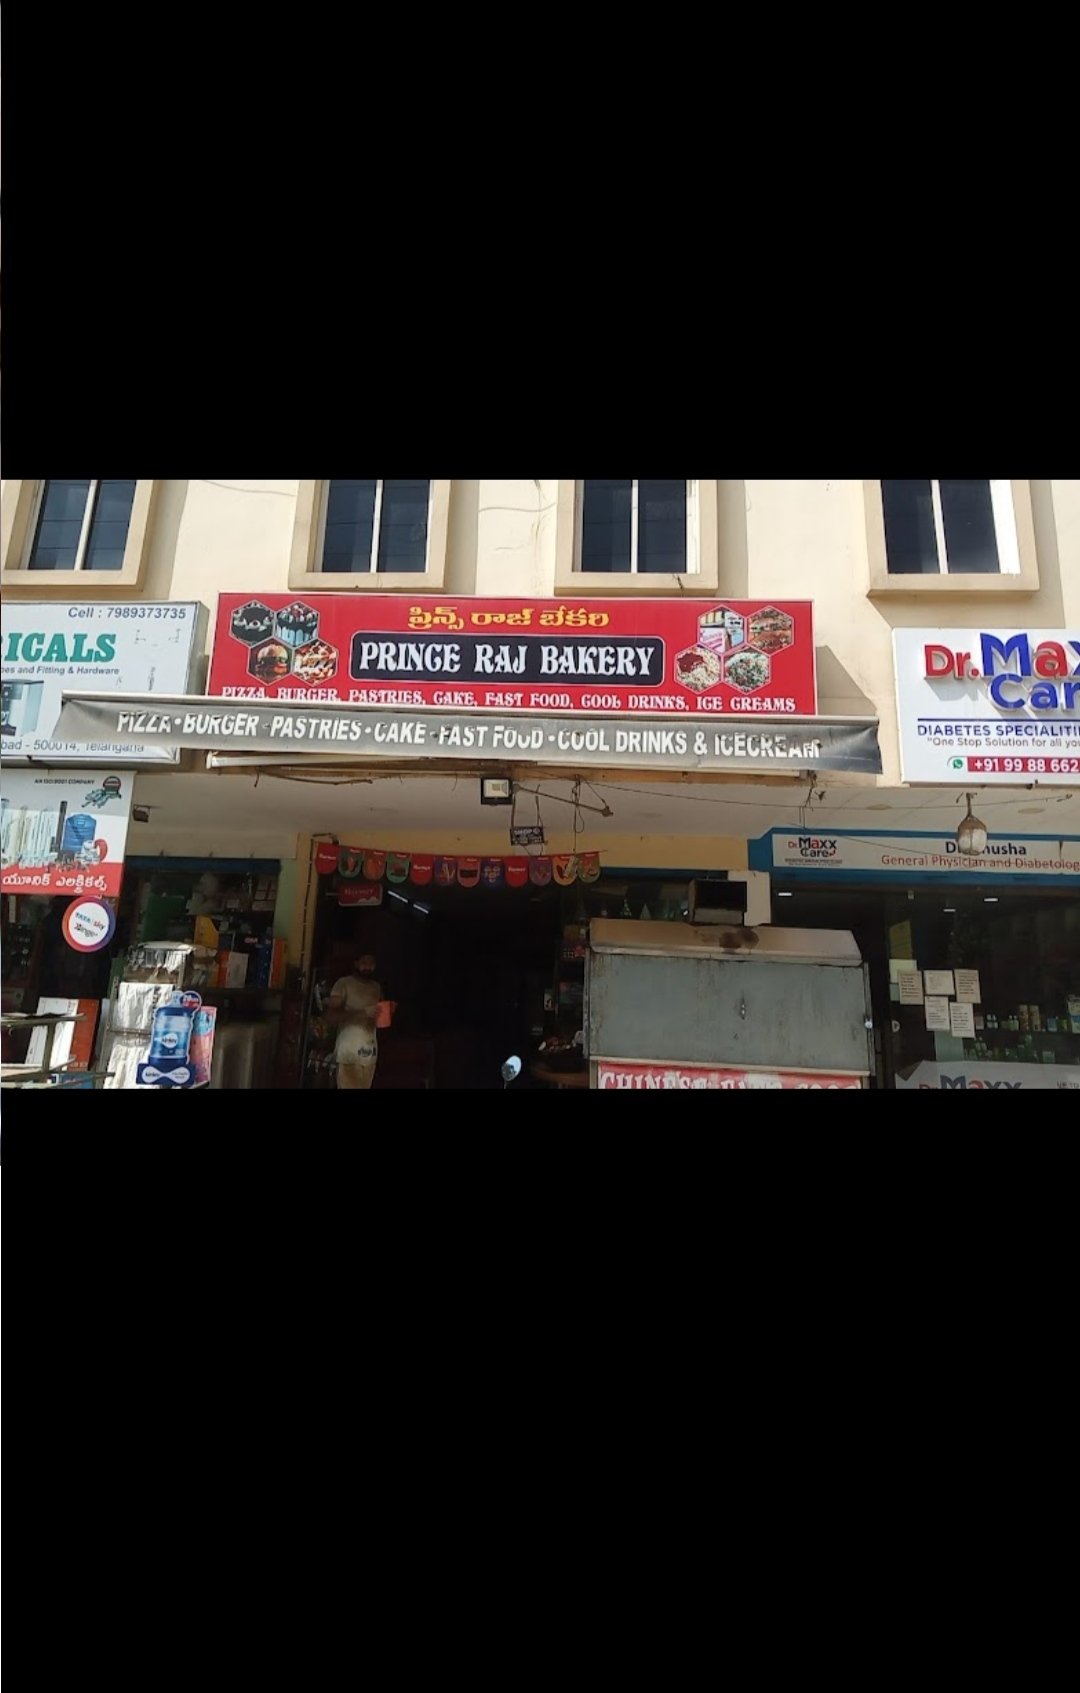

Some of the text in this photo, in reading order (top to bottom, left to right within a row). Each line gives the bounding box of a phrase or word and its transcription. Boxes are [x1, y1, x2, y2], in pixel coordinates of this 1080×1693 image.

[68, 606, 94, 619] Cell
[107, 607, 187, 620] 7989373735
[471, 608, 535, 626] రాజ్
[539, 605, 609, 627] బేకరి
[359, 641, 655, 676] PRINCE RAJ BAKERY
[17, 666, 35, 674] and
[37, 666, 65, 676] Fitting
[67, 667, 74, 675] &
[77, 667, 120, 675] Hardware
[485, 692, 524, 706] FAST
[530, 693, 573, 708] FOOD,
[628, 695, 690, 711] DRINKS,
[270, 715, 362, 741] PASTRIES
[374, 720, 427, 744] CAKE
[557, 727, 610, 752] COOL
[615, 730, 687, 755] DRINKS
[693, 731, 708, 755] &
[917, 725, 991, 737] DIABETES
[958, 738, 982, 748] Stop
[985, 738, 1028, 747] Solution
[1032, 738, 1046, 747] for
[1050, 738, 1062, 747] all
[974, 758, 1079, 773] +91 99 88 662
[882, 855, 928, 866] General
[931, 855, 985, 869] Physician
[988, 857, 1011, 868] and
